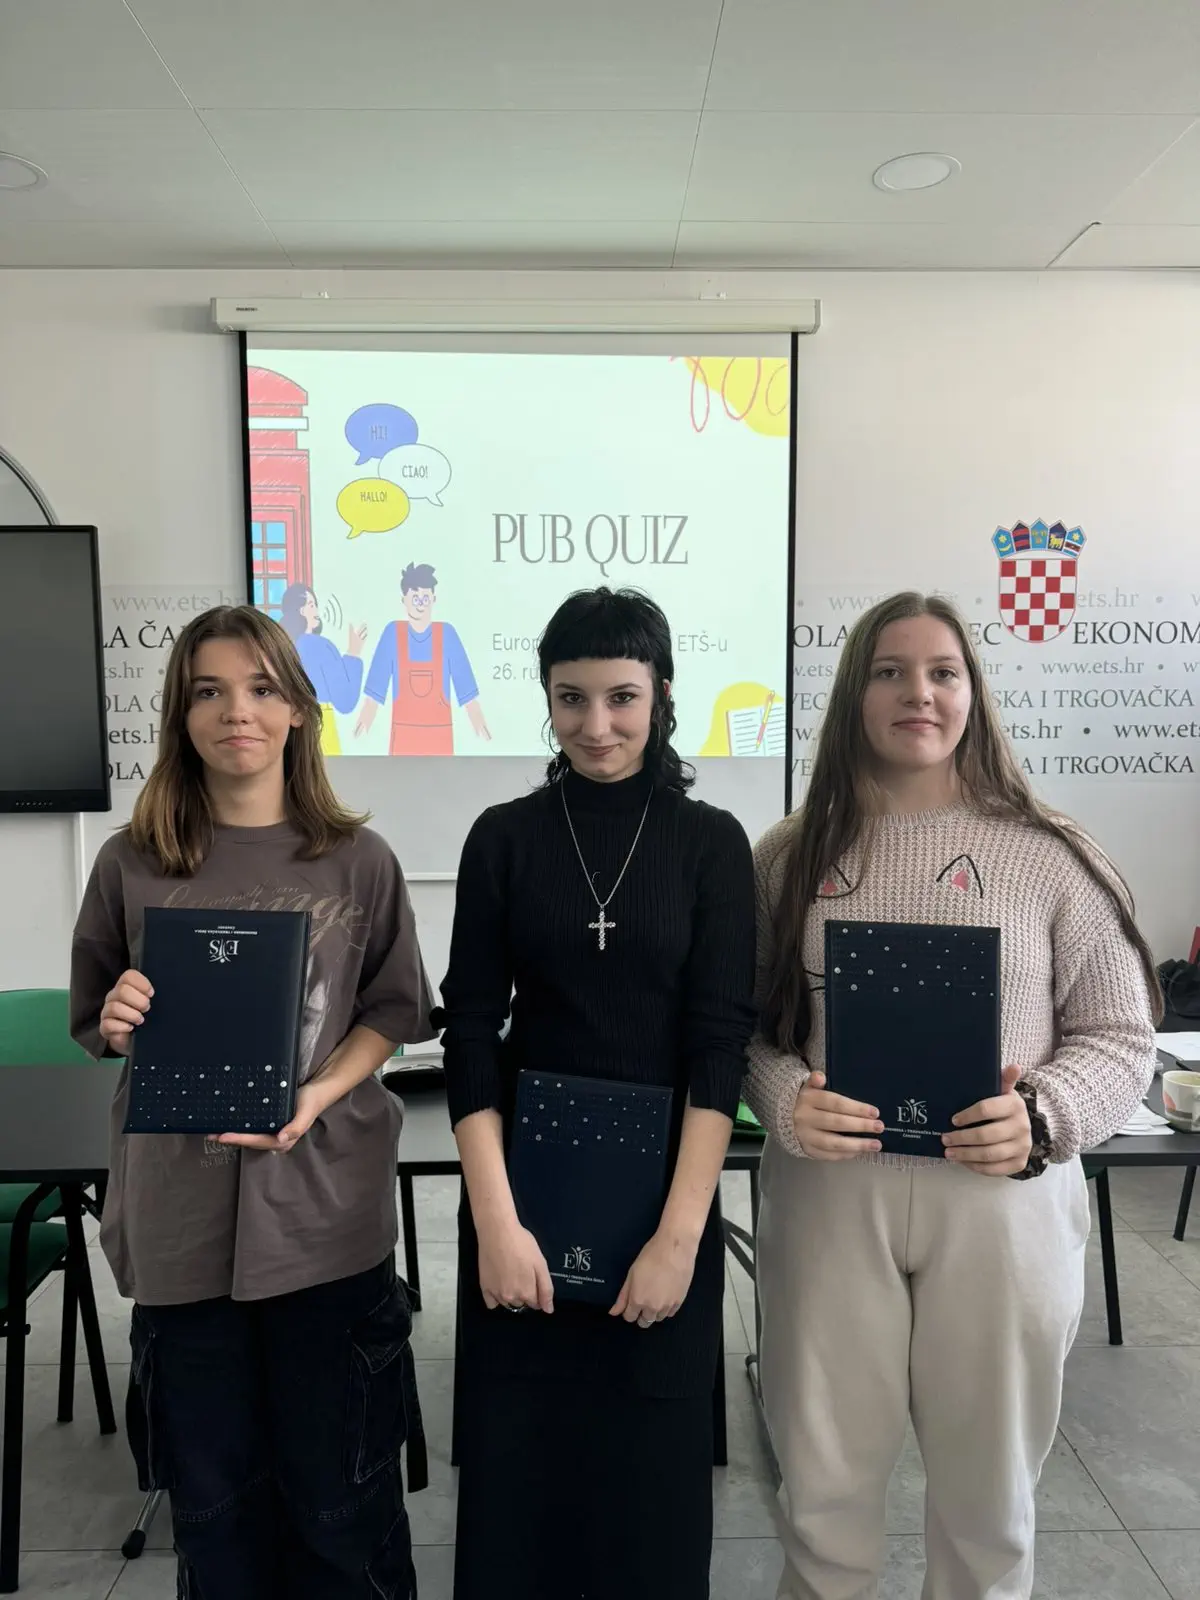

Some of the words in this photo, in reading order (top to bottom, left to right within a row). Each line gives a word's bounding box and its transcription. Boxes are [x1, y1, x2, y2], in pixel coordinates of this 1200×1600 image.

[370, 425, 388, 441] HI!
[402, 465, 428, 479] CIAO!
[360, 491, 388, 503] HALLO!
[492, 513, 575, 564] PUB
[585, 513, 689, 578] QUIZ
[677, 630, 728, 652] ETŠ-u
[492, 663, 517, 681] 26.
[1041, 656, 1144, 675] www.ets.hr
[1041, 690, 1048, 708] I
[1054, 685, 1195, 708] TRGOVAČKA
[1041, 757, 1048, 775] I
[1055, 752, 1195, 775] TRGOVAČKA
